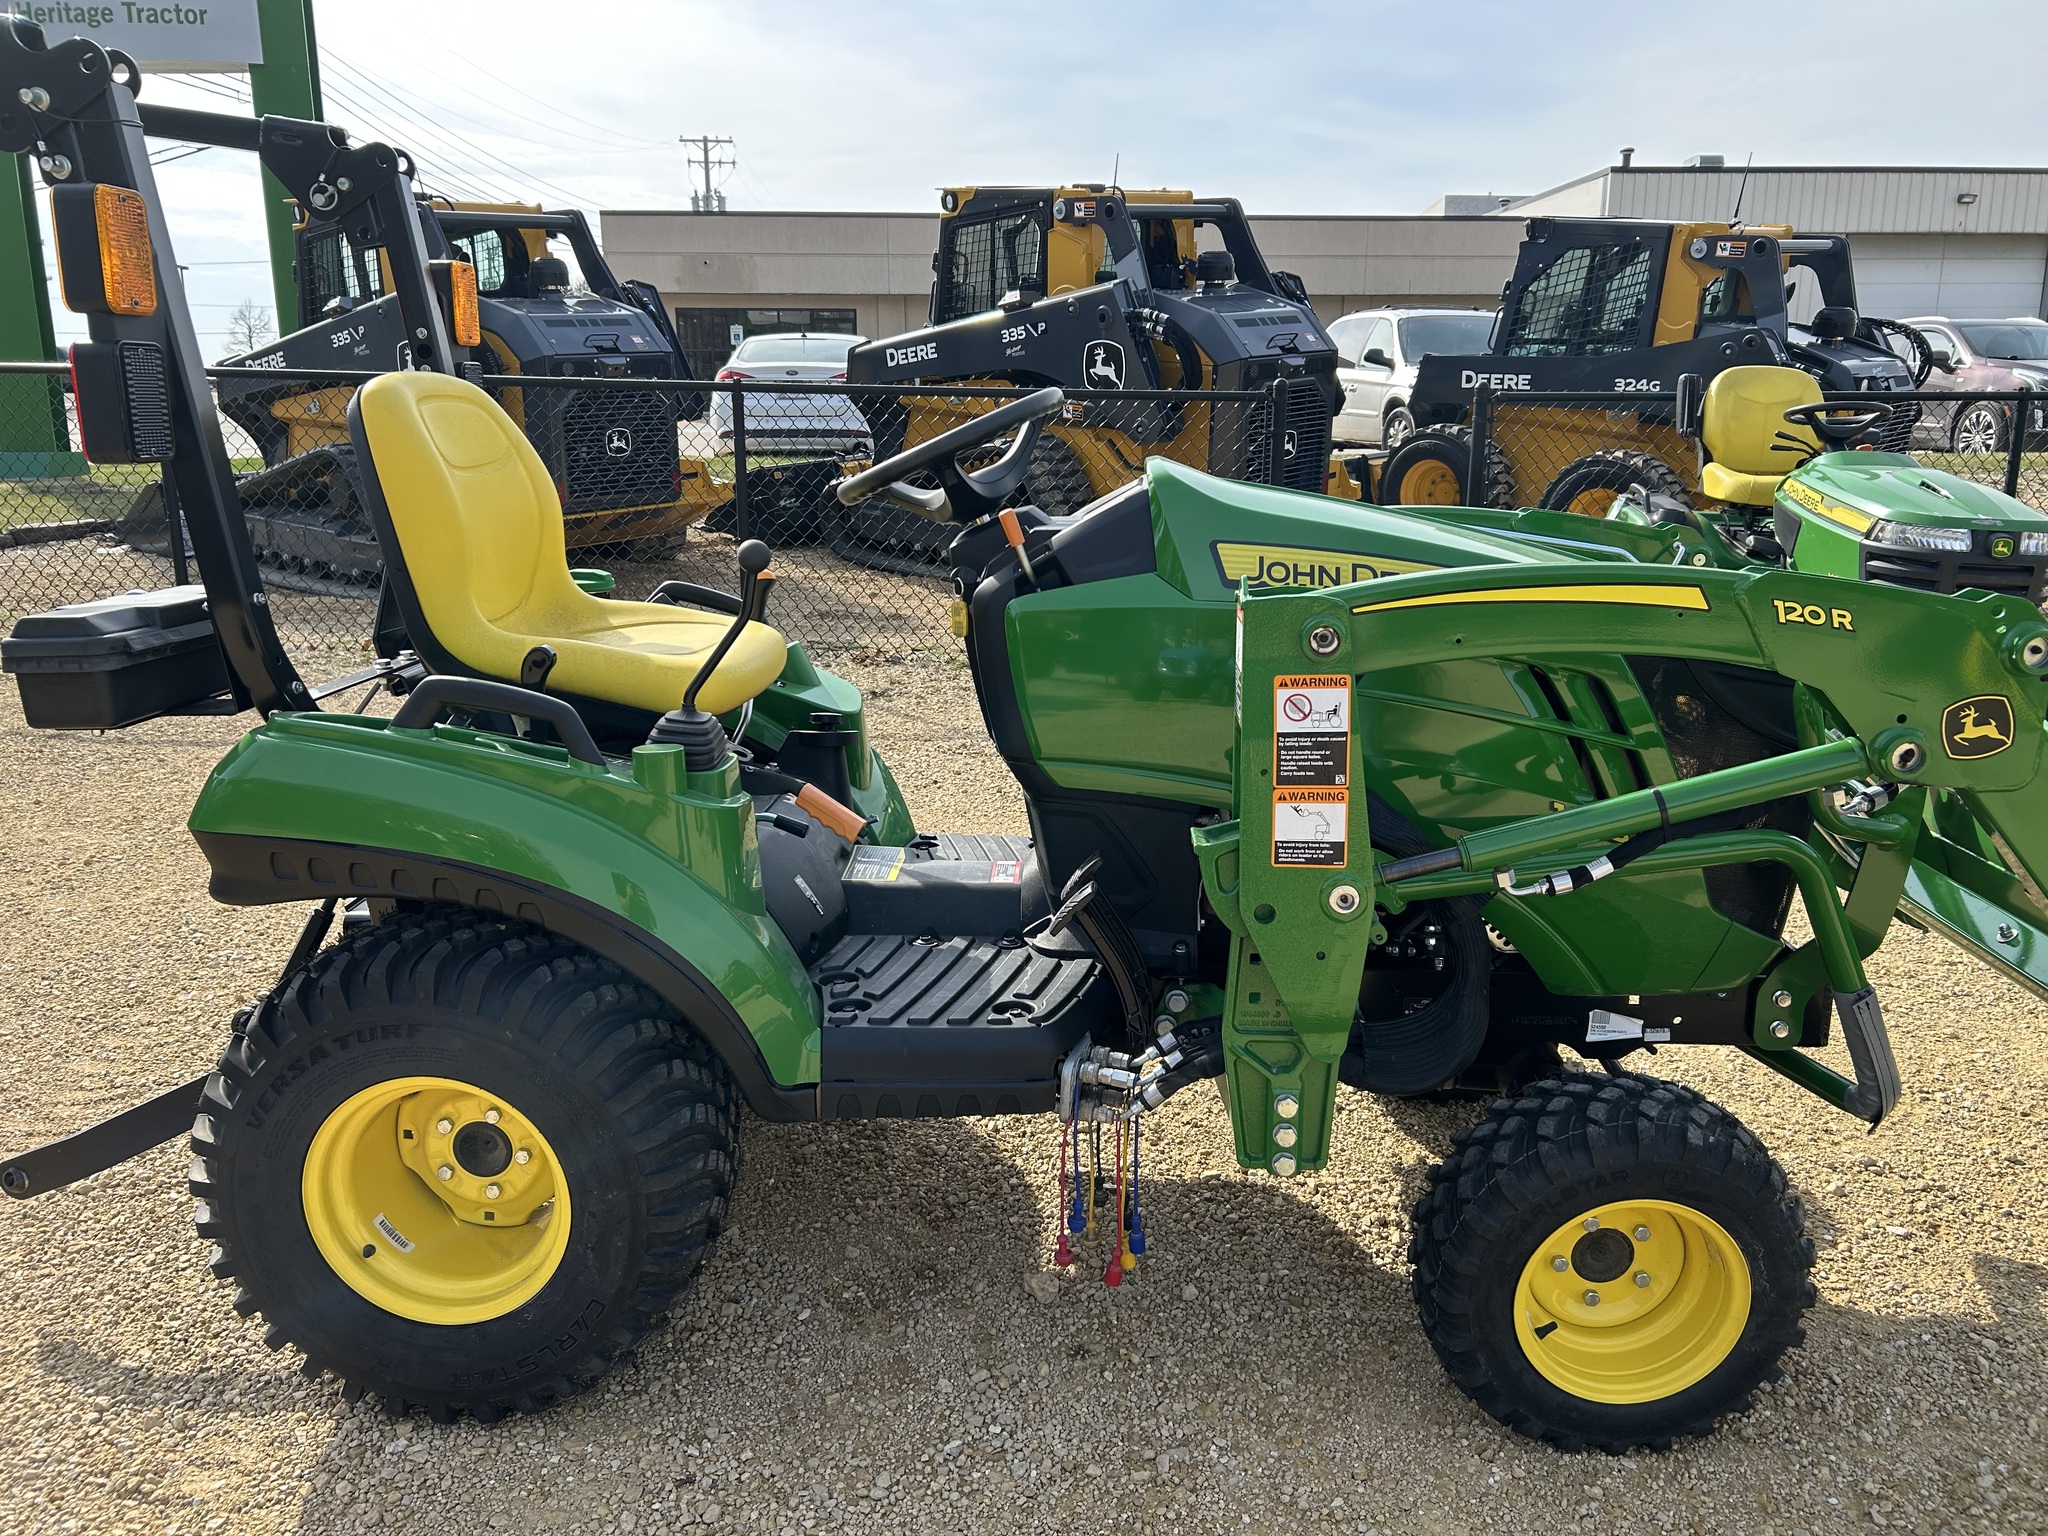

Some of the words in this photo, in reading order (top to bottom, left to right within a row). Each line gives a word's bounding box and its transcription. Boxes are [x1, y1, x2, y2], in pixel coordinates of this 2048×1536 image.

[15, 1, 114, 28] Heritage
[120, 1, 208, 25] Tractor
[885, 342, 938, 367] DEERE
[1614, 378, 1661, 392] 324G
[1799, 489, 1820, 511] DEERE
[1246, 556, 1341, 587] JOHN
[1290, 677, 1347, 687] WARNING
[1288, 791, 1345, 801] WARNING
[245, 1043, 352, 1130] VERSA
[332, 1023, 427, 1052] TURF
[1507, 1169, 1630, 1243] CARLSTAR
[450, 1297, 608, 1391] CARLSTAR
